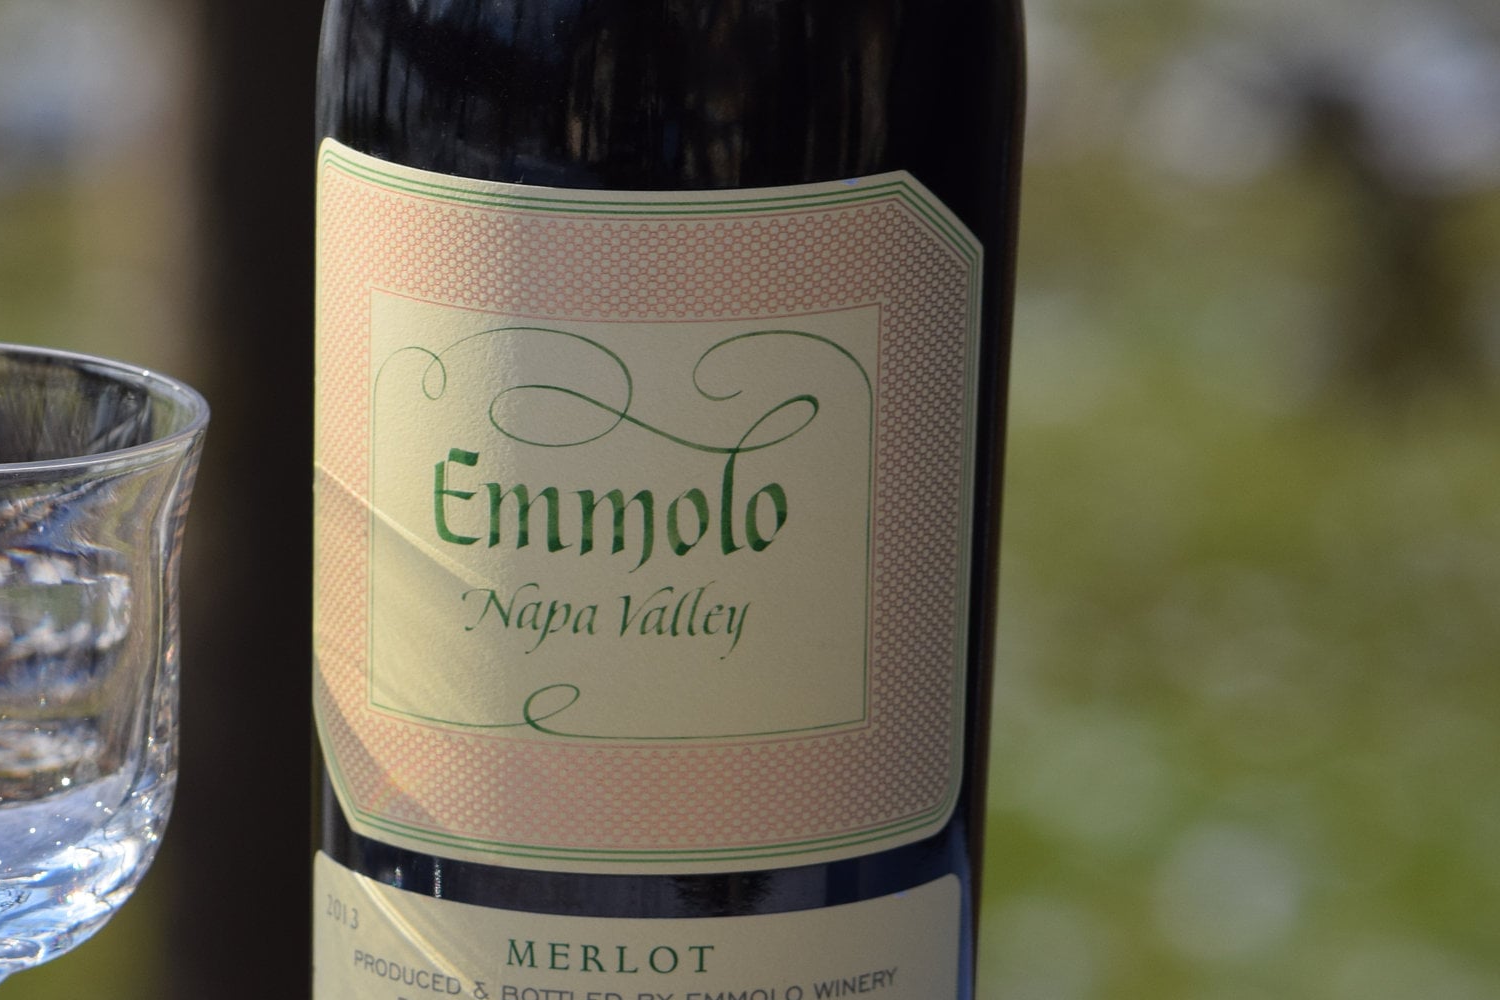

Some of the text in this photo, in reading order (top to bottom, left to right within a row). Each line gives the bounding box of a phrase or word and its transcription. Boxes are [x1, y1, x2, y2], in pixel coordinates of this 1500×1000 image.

[434, 446, 788, 574] Emmolo
[461, 580, 752, 660] Napa Valley
[326, 894, 359, 930] 2013
[353, 949, 462, 996] PRODUCED
[472, 980, 490, 1000] &
[812, 967, 899, 1000] WINERY
[506, 938, 715, 974] MERLOT
